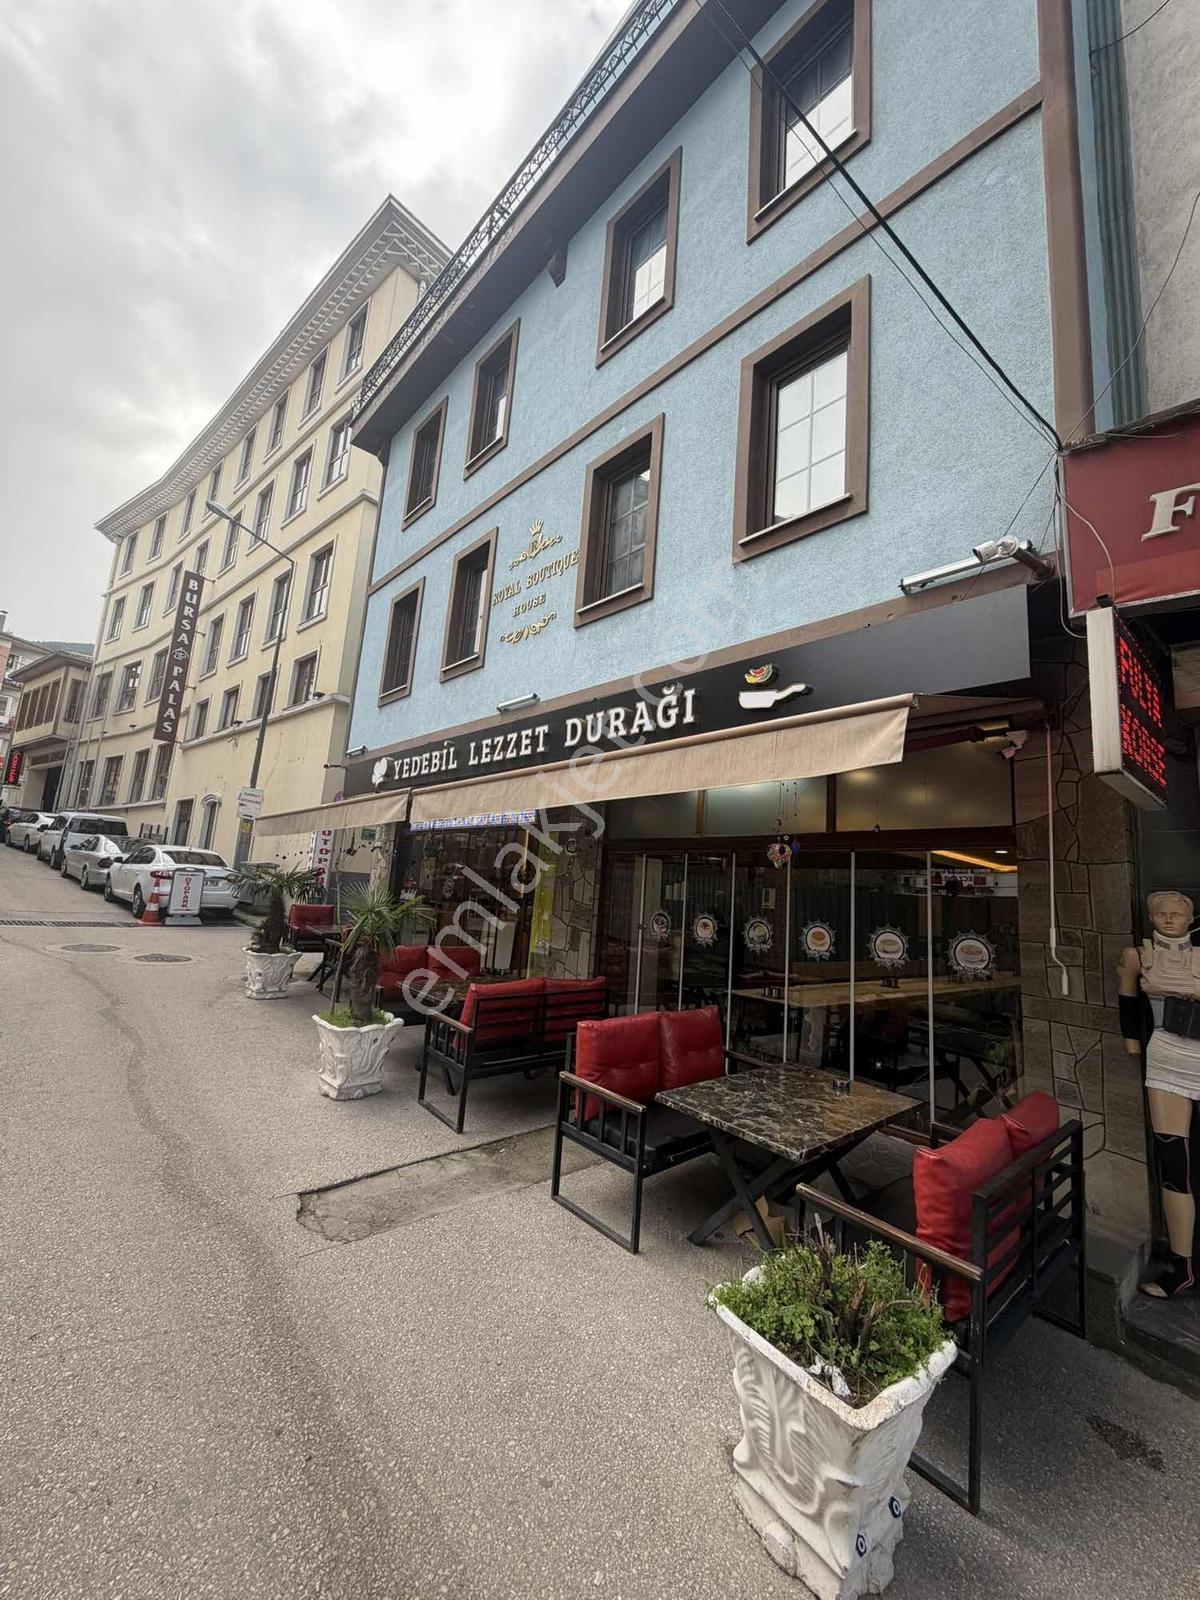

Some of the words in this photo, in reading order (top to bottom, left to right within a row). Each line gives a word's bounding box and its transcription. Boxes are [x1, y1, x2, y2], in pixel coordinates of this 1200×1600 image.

[493, 580, 521, 606] ROYAL
[526, 547, 579, 589] BOUTIQUE
[512, 593, 546, 617] HOUSE
[177, 579, 199, 645] BURSA
[162, 666, 183, 733] PALAS
[393, 740, 458, 780] YEDEBİL
[469, 724, 549, 766] LEZZET
[564, 685, 696, 748] DURAĞI
[315, 829, 332, 887] OTOPAR
[181, 877, 192, 908] OTOPARK
